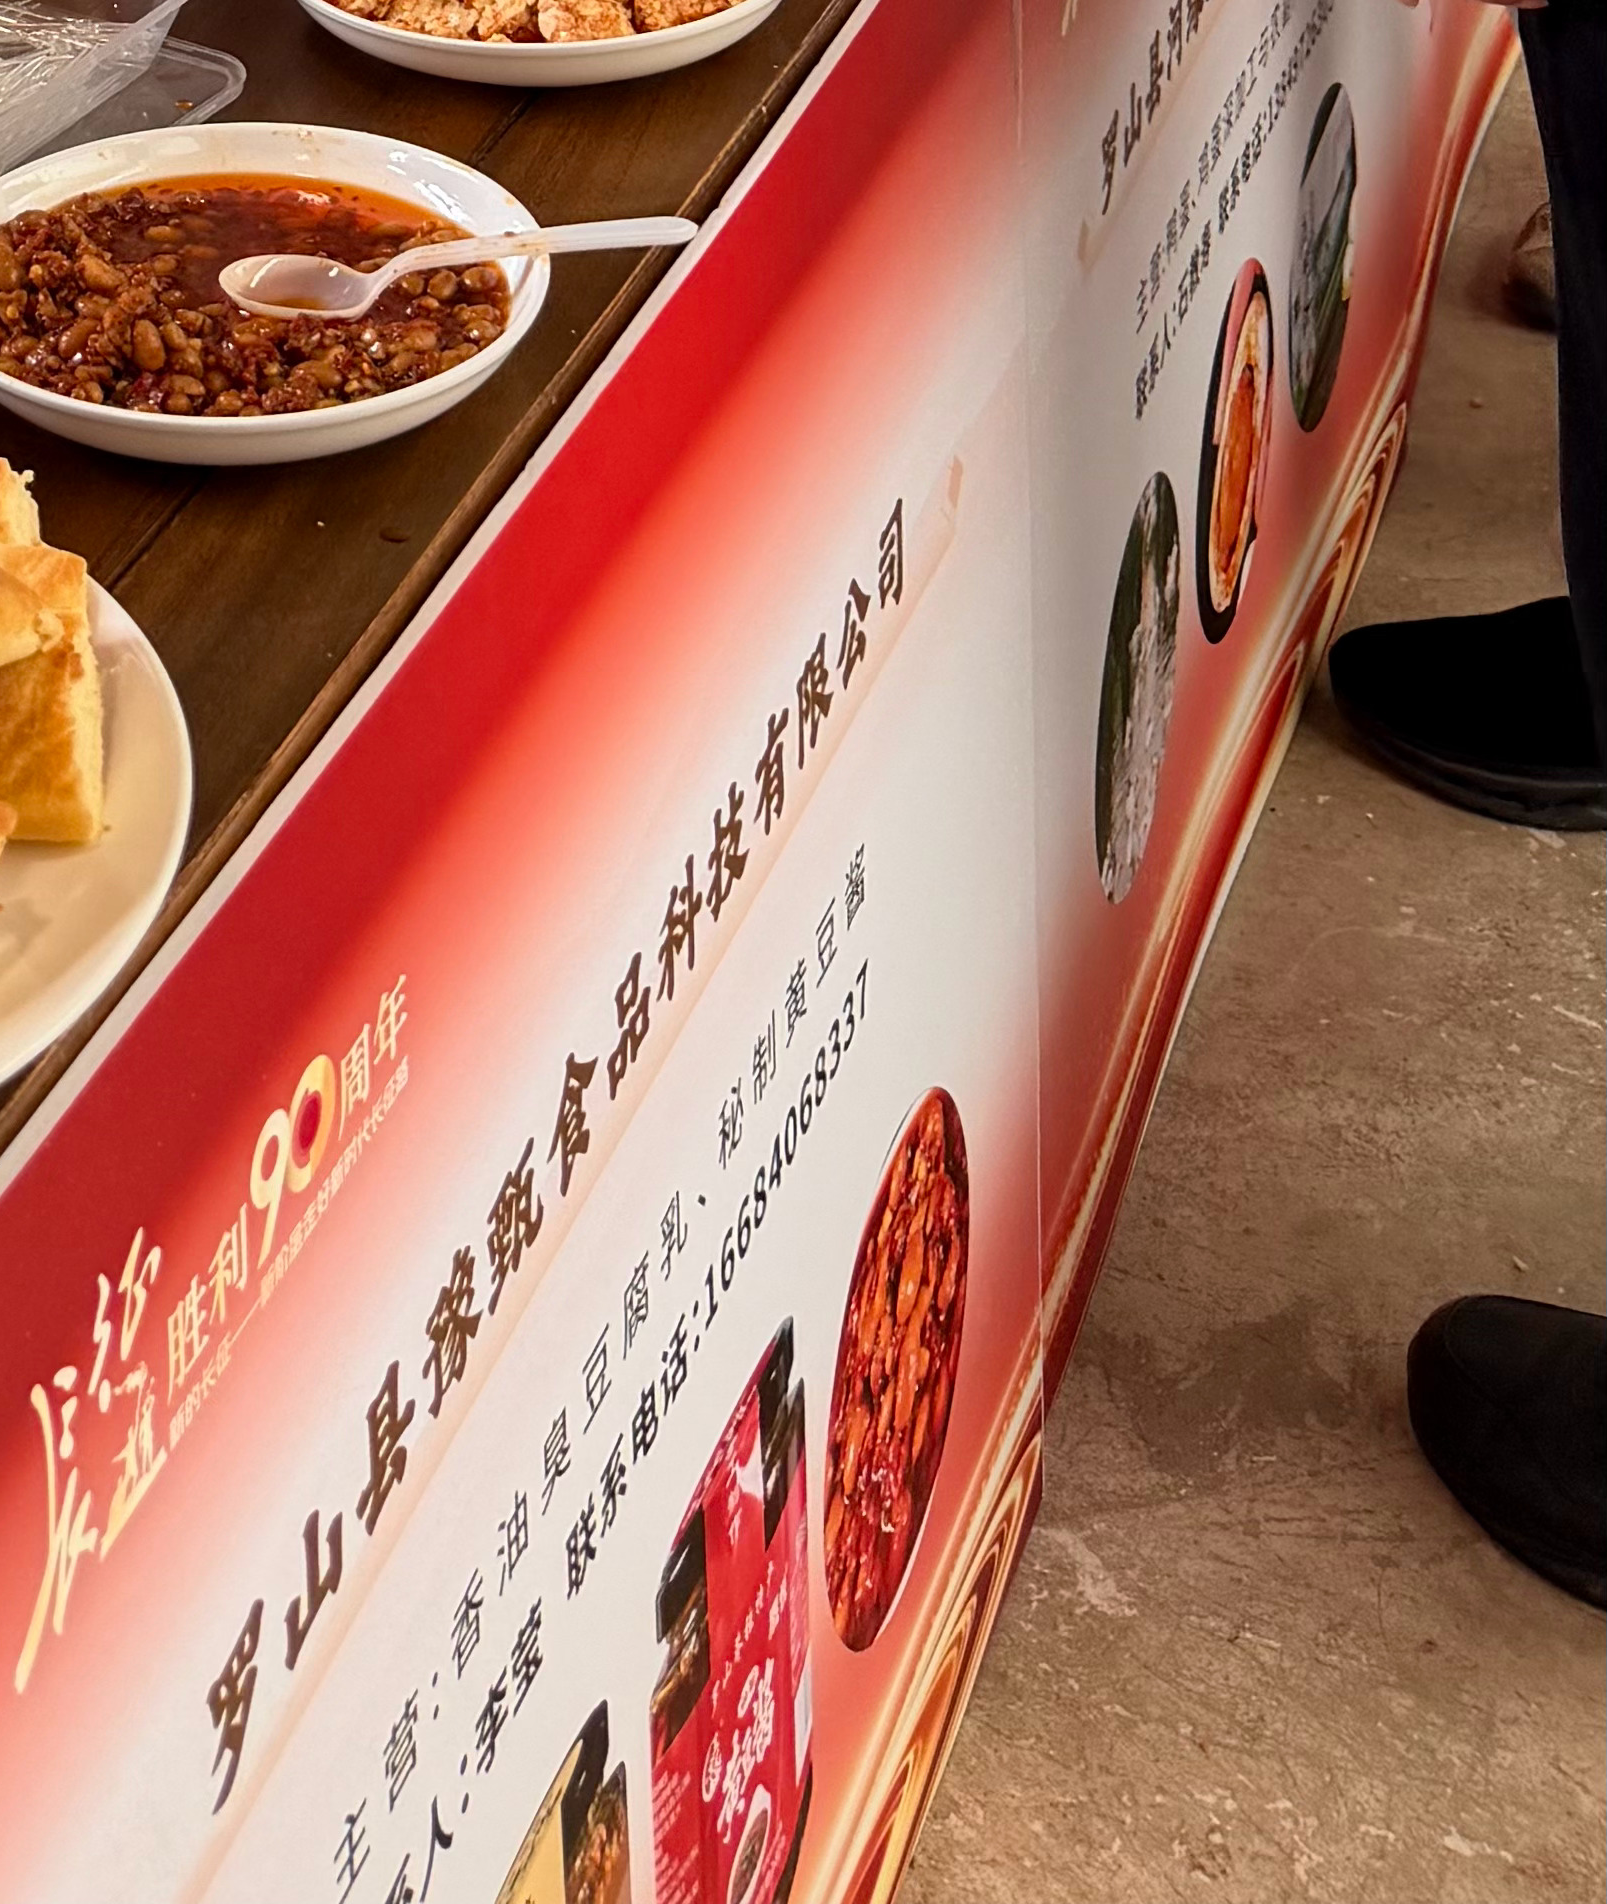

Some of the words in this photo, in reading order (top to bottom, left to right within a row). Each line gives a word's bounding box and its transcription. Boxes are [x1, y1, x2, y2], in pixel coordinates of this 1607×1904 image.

[167, 975, 407, 1405] 胜利90周年
[205, 498, 905, 1815] 罗山县豫甄食品科技有限公司
